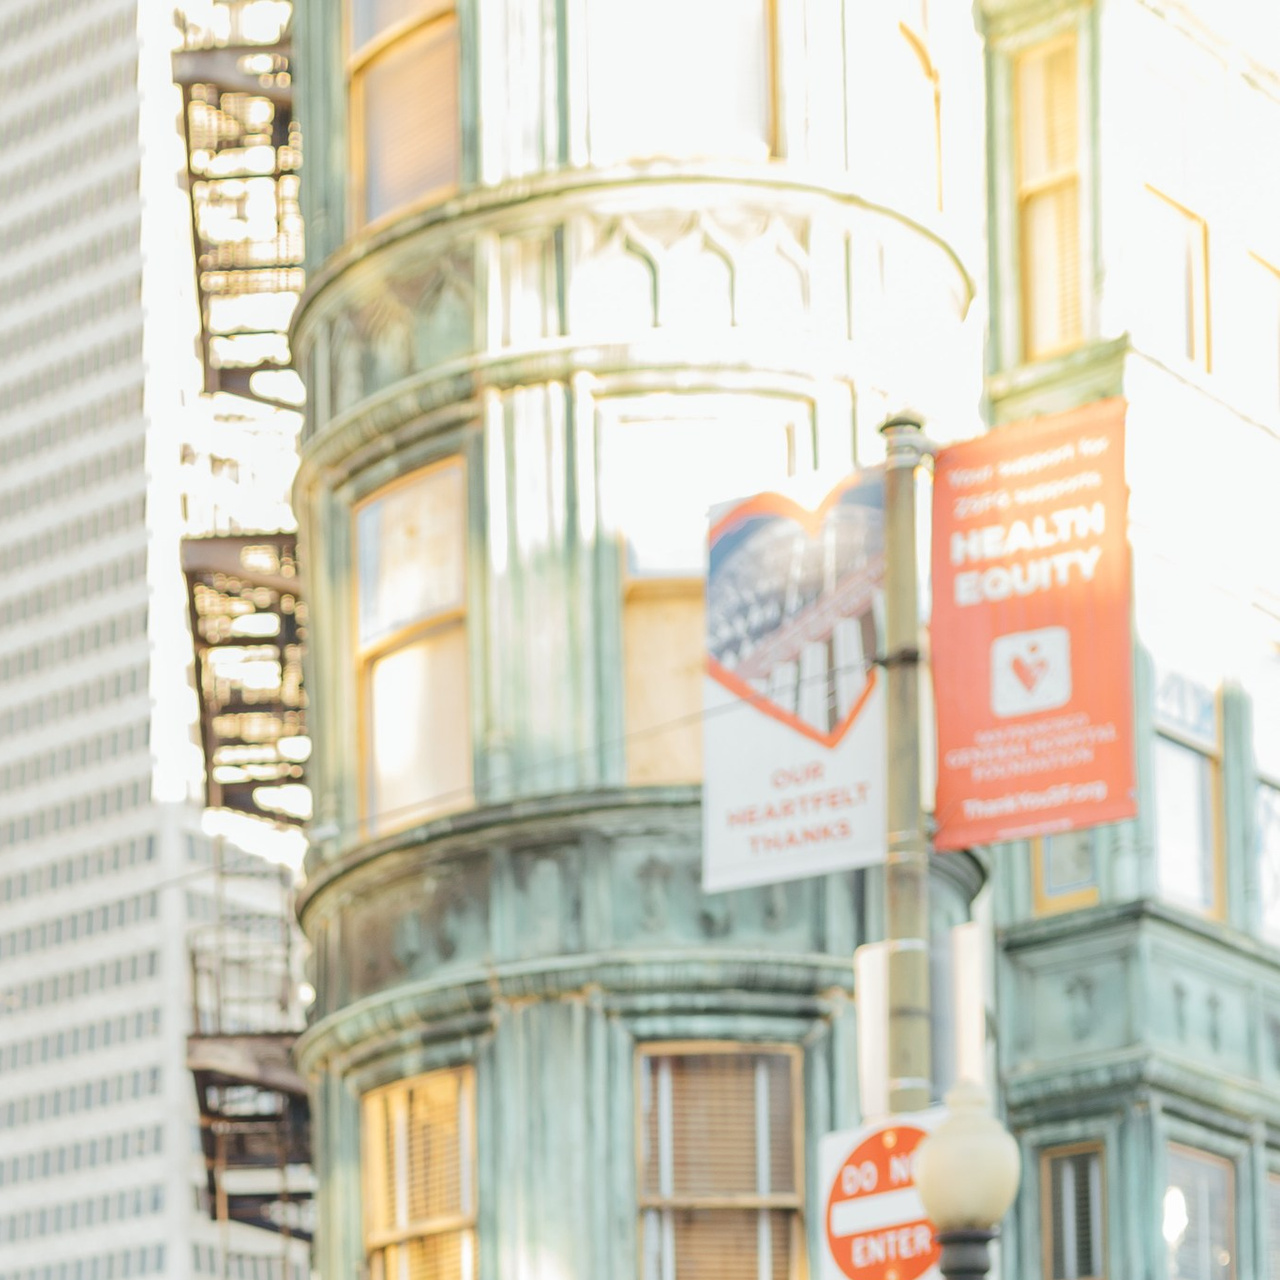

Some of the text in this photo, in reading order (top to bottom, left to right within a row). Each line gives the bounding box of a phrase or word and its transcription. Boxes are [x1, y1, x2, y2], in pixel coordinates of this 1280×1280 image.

[950, 501, 1106, 566] HEALTH
[953, 546, 1102, 606] EQUITY
[772, 760, 824, 790] OUR
[727, 782, 870, 830] HEARTFELT
[749, 819, 851, 856] THANKS
[842, 1160, 878, 1196] DO
[851, 1224, 932, 1269] ENTER
